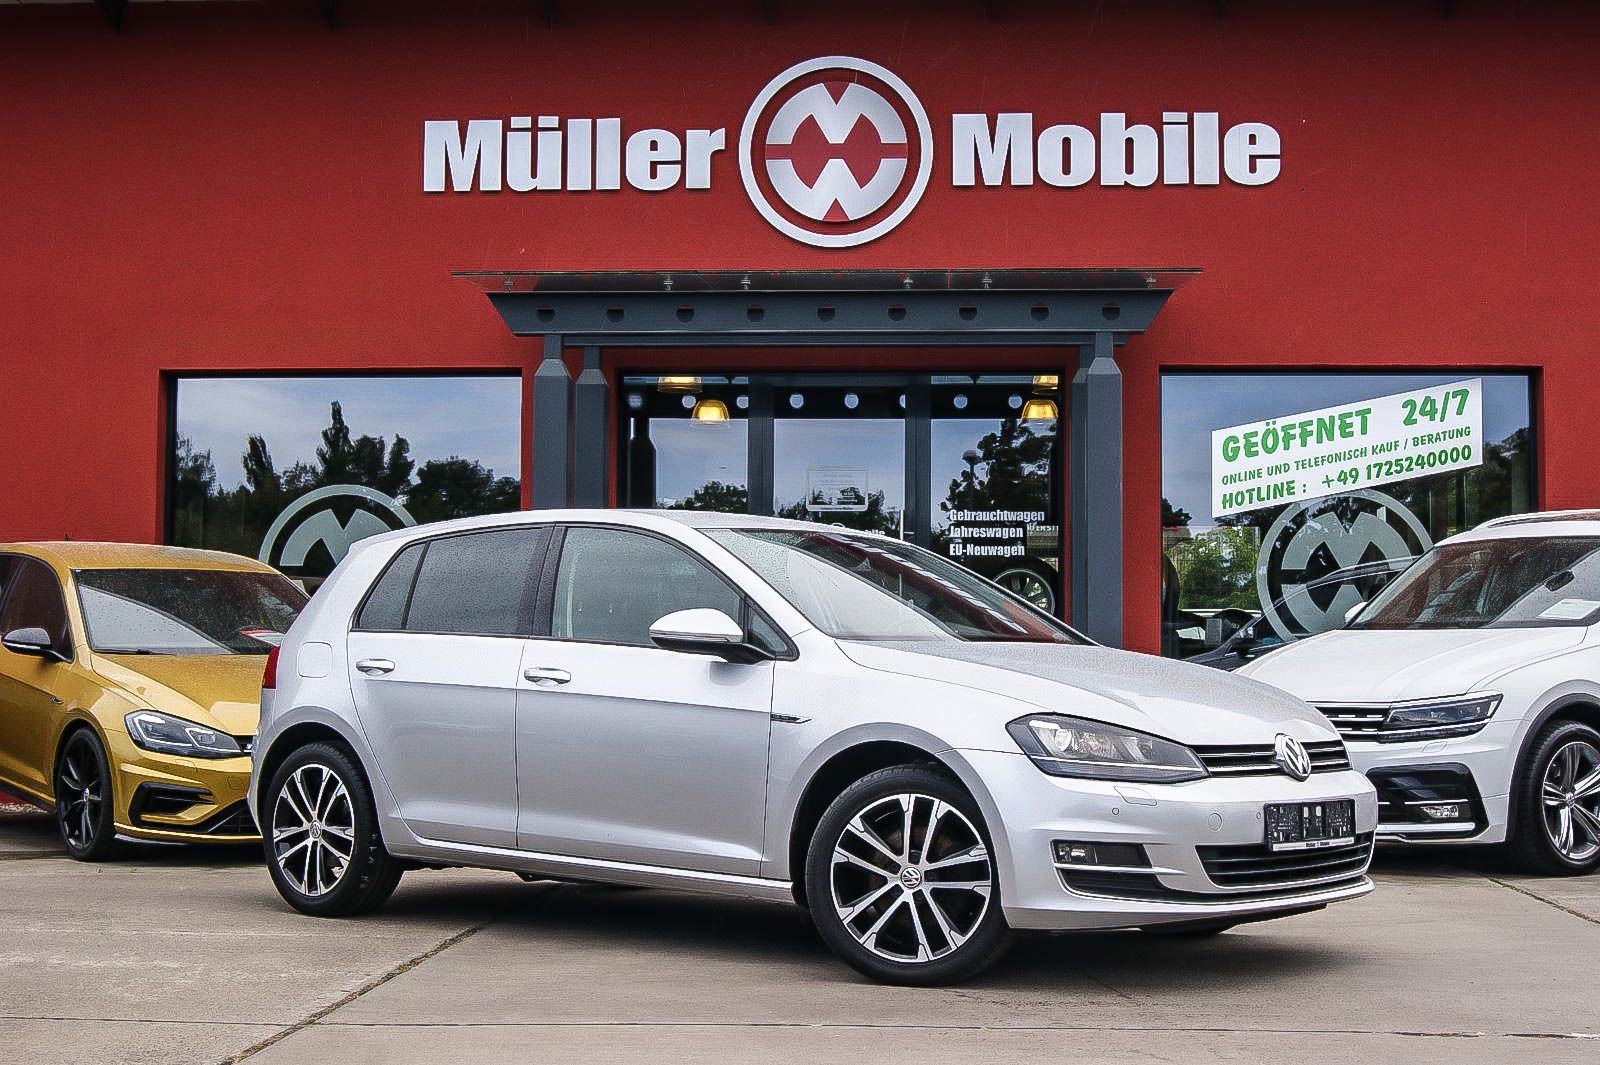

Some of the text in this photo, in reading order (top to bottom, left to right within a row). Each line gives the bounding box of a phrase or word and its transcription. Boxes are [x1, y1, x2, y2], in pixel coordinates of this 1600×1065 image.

[423, 111, 1281, 192] Müller Mobile
[1222, 388, 1470, 462] GEÖFFNET 24/7
[1221, 468, 1263, 486] ONLINE
[1266, 462, 1291, 476] UND
[1294, 446, 1368, 471] TELEFONISCH
[1371, 440, 1400, 456] KAUF
[1412, 426, 1472, 448] BERATUNG
[1221, 480, 1296, 510] HOTLINE
[1321, 467, 1360, 488] +49
[1365, 444, 1472, 481] 1725240000
[949, 508, 1045, 523] Gebrauchtwagen
[949, 525, 1024, 539] Jahreswagen
[949, 543, 1026, 558] EU-Neuwagen
